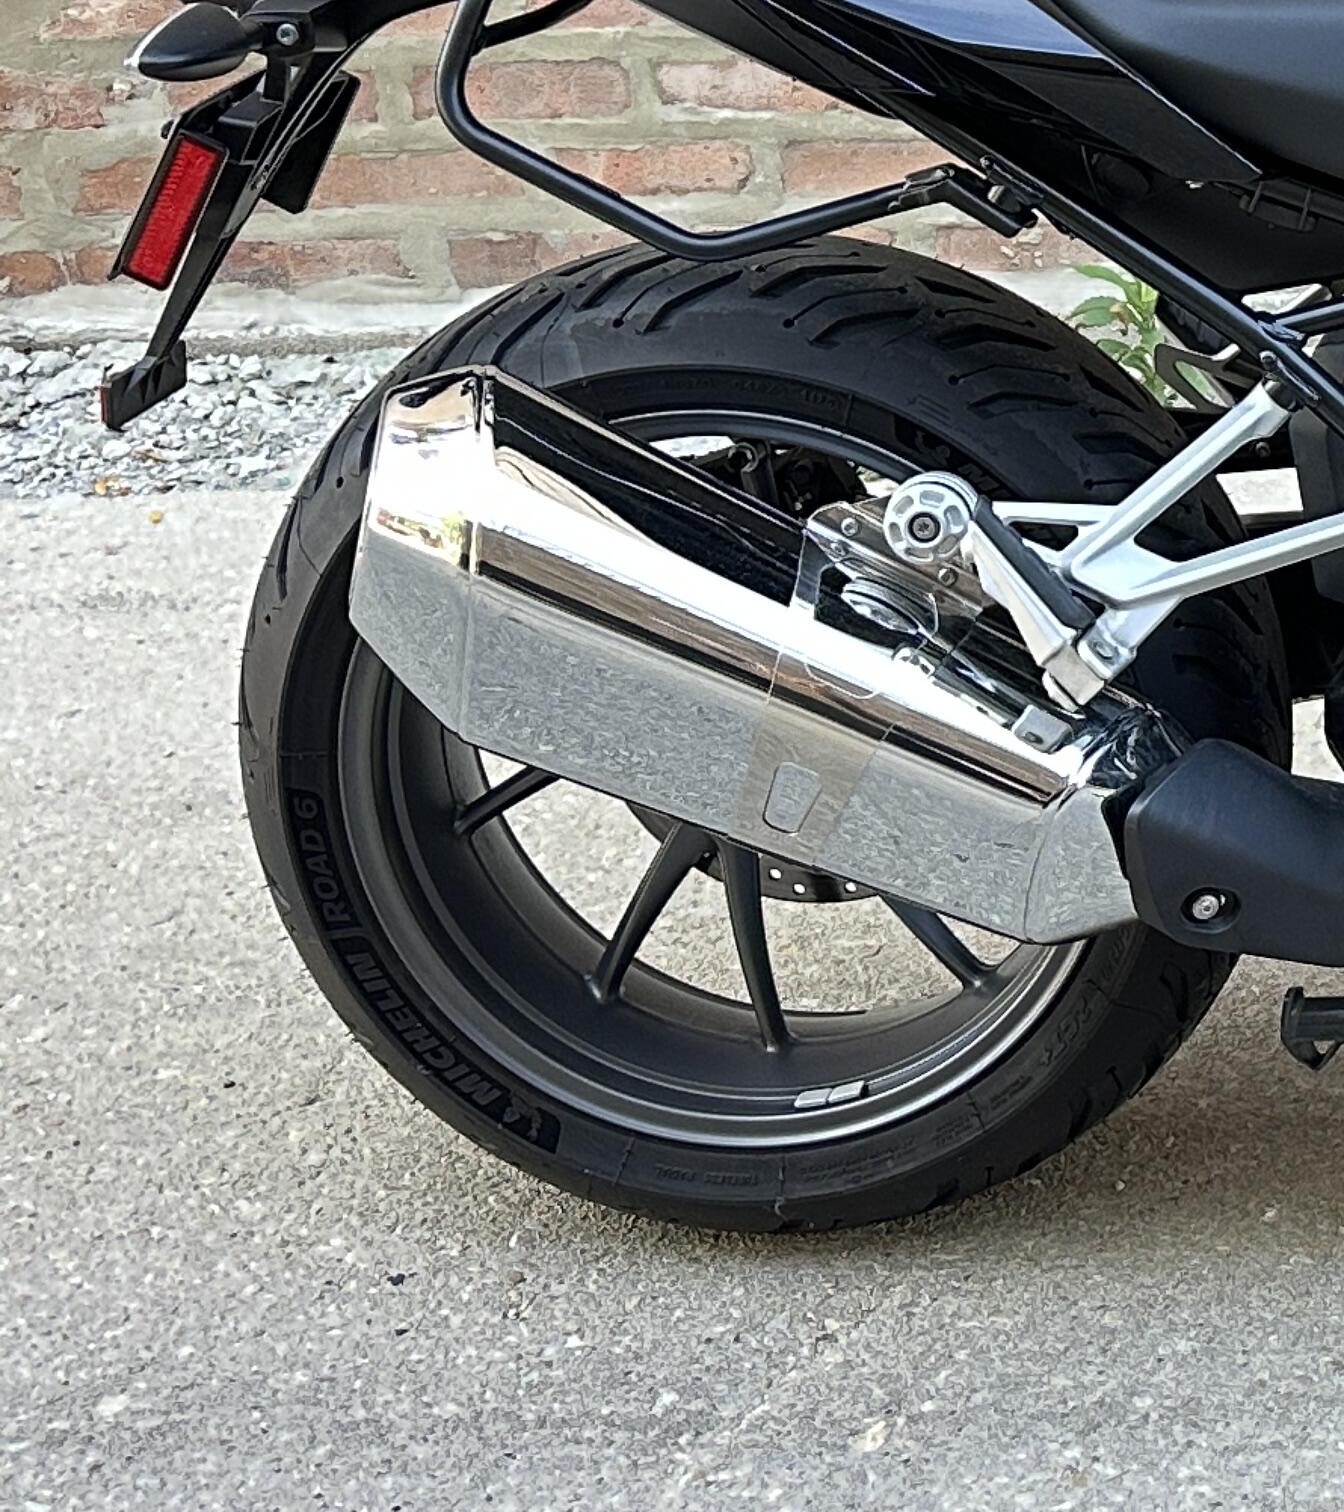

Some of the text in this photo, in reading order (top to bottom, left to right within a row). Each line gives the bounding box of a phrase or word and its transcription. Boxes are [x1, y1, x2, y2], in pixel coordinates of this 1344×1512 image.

[294, 796, 503, 1106] MICHELIN ROAD 6
